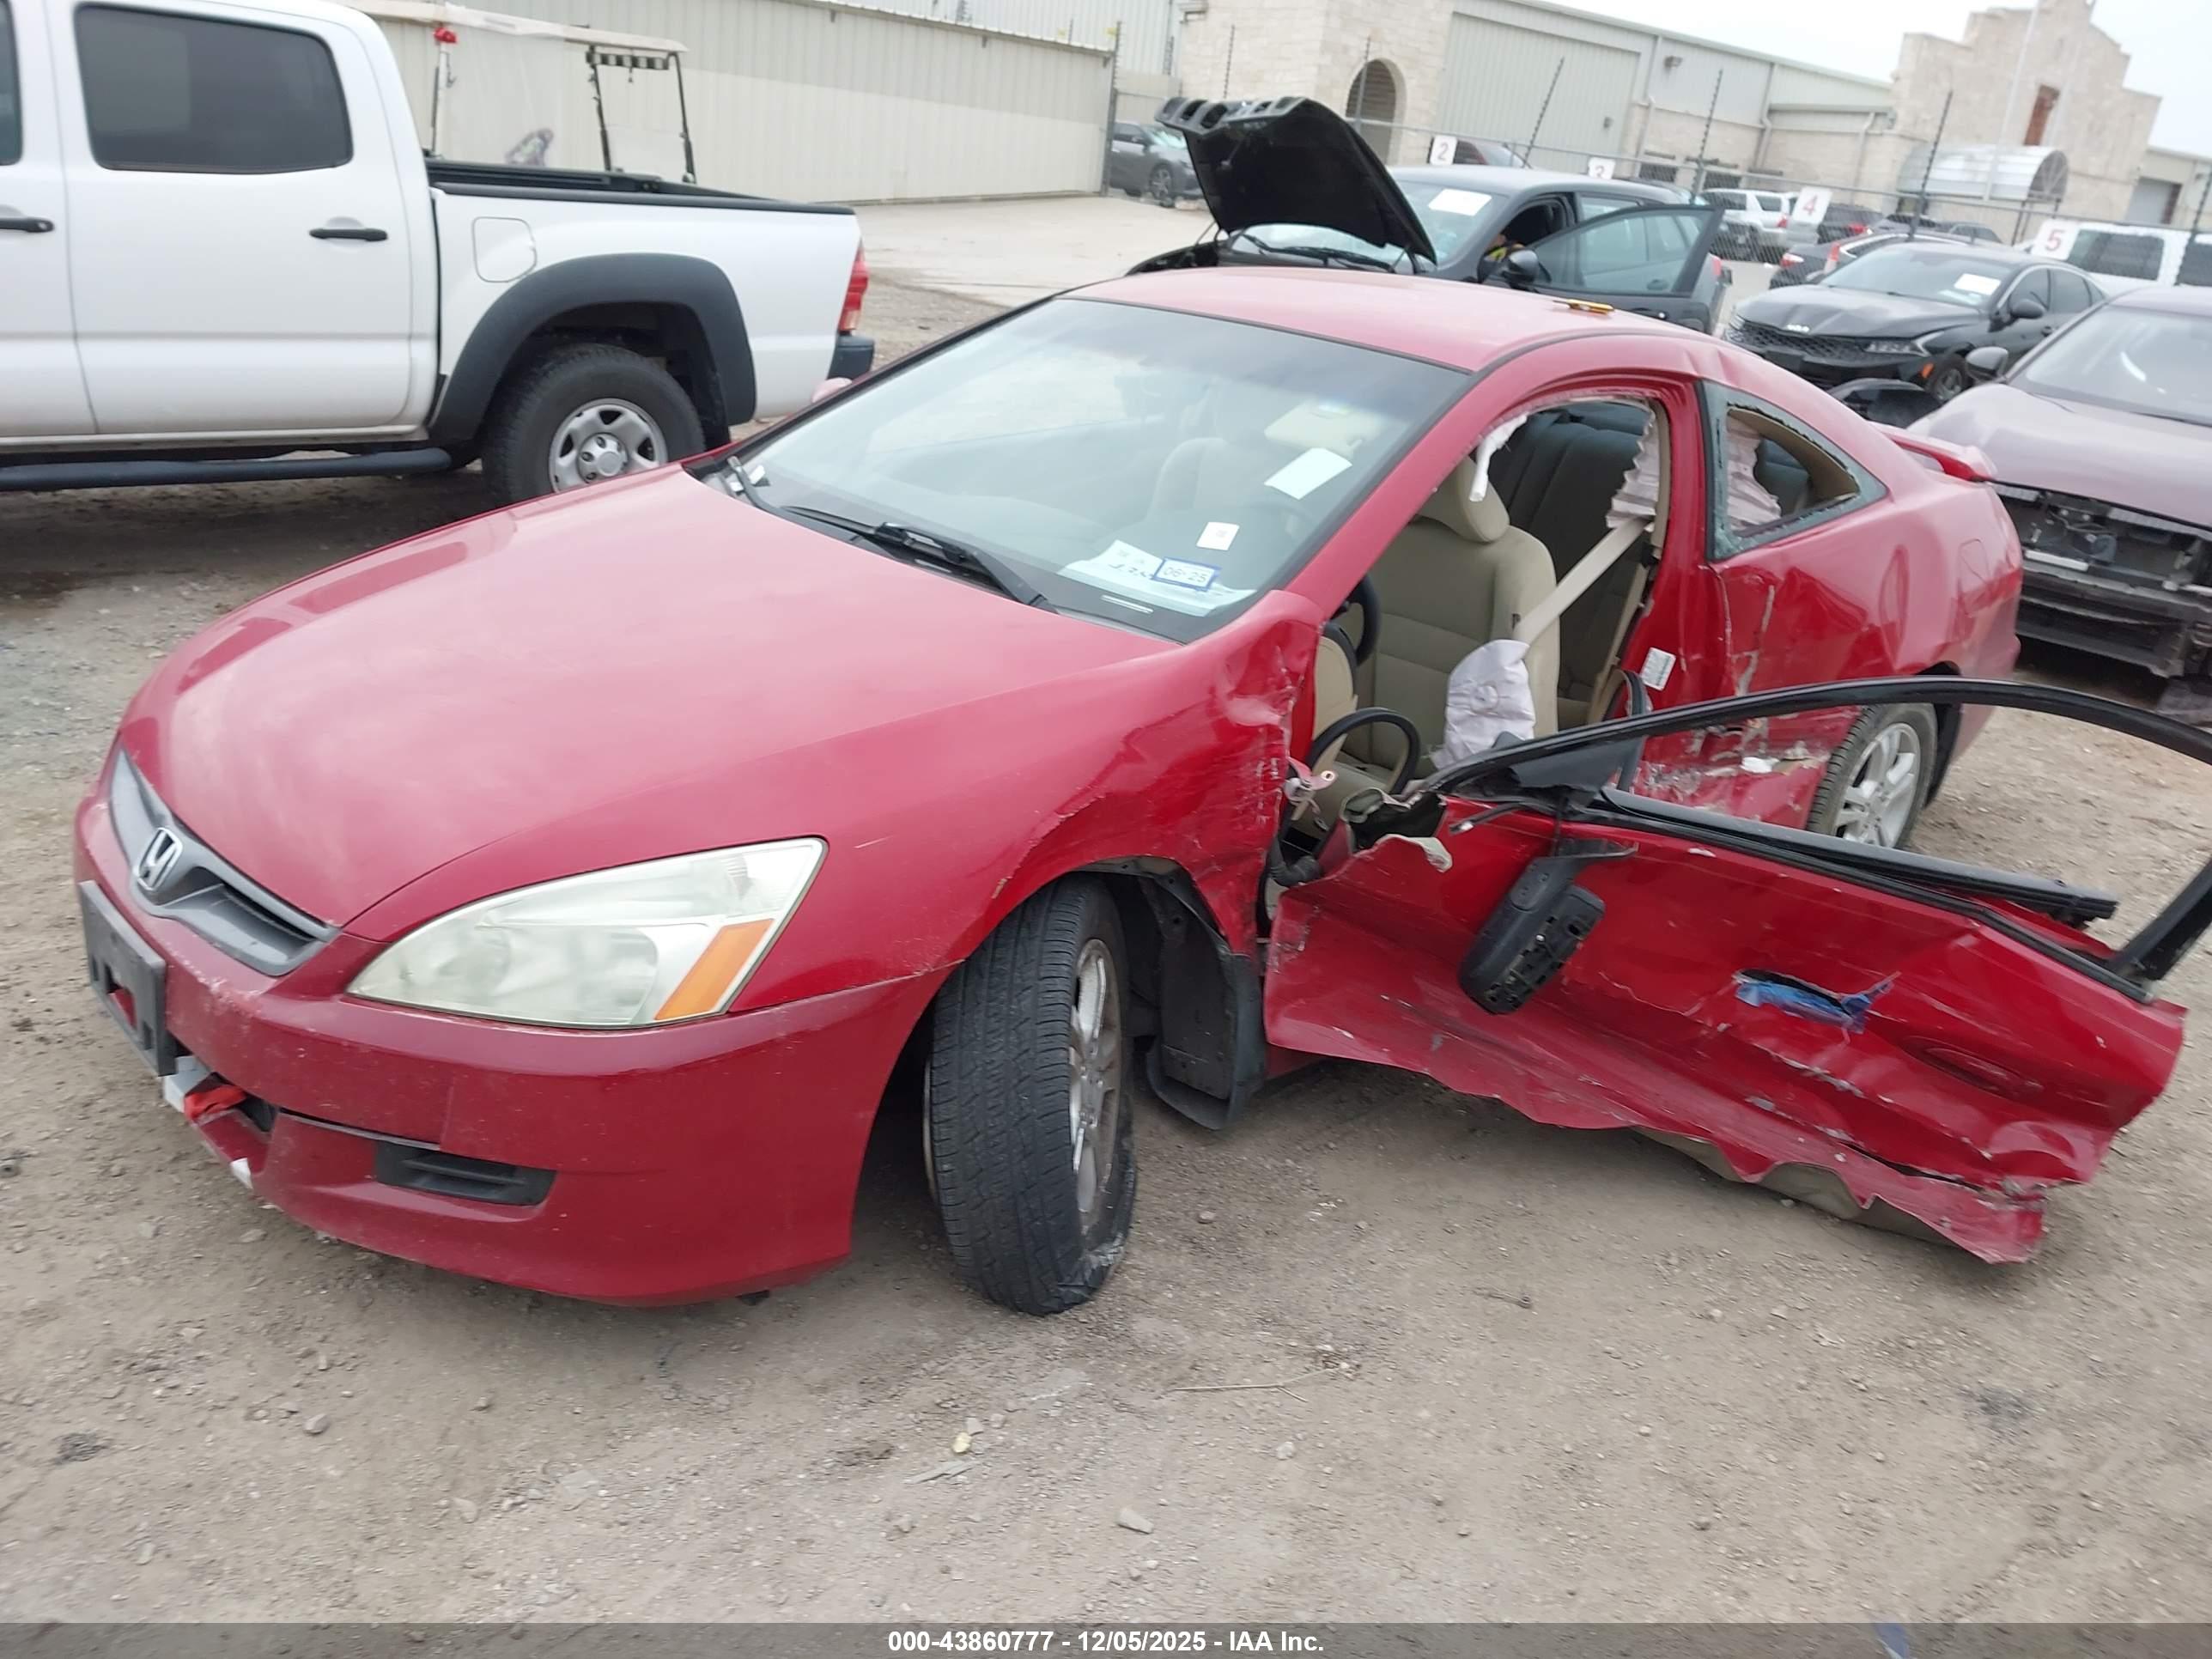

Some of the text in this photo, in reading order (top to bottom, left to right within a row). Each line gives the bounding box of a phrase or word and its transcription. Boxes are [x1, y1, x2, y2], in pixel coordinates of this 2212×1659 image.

[1437, 141, 1449, 161] 2
[1802, 194, 1818, 216] 4
[2045, 228, 2066, 252] 5
